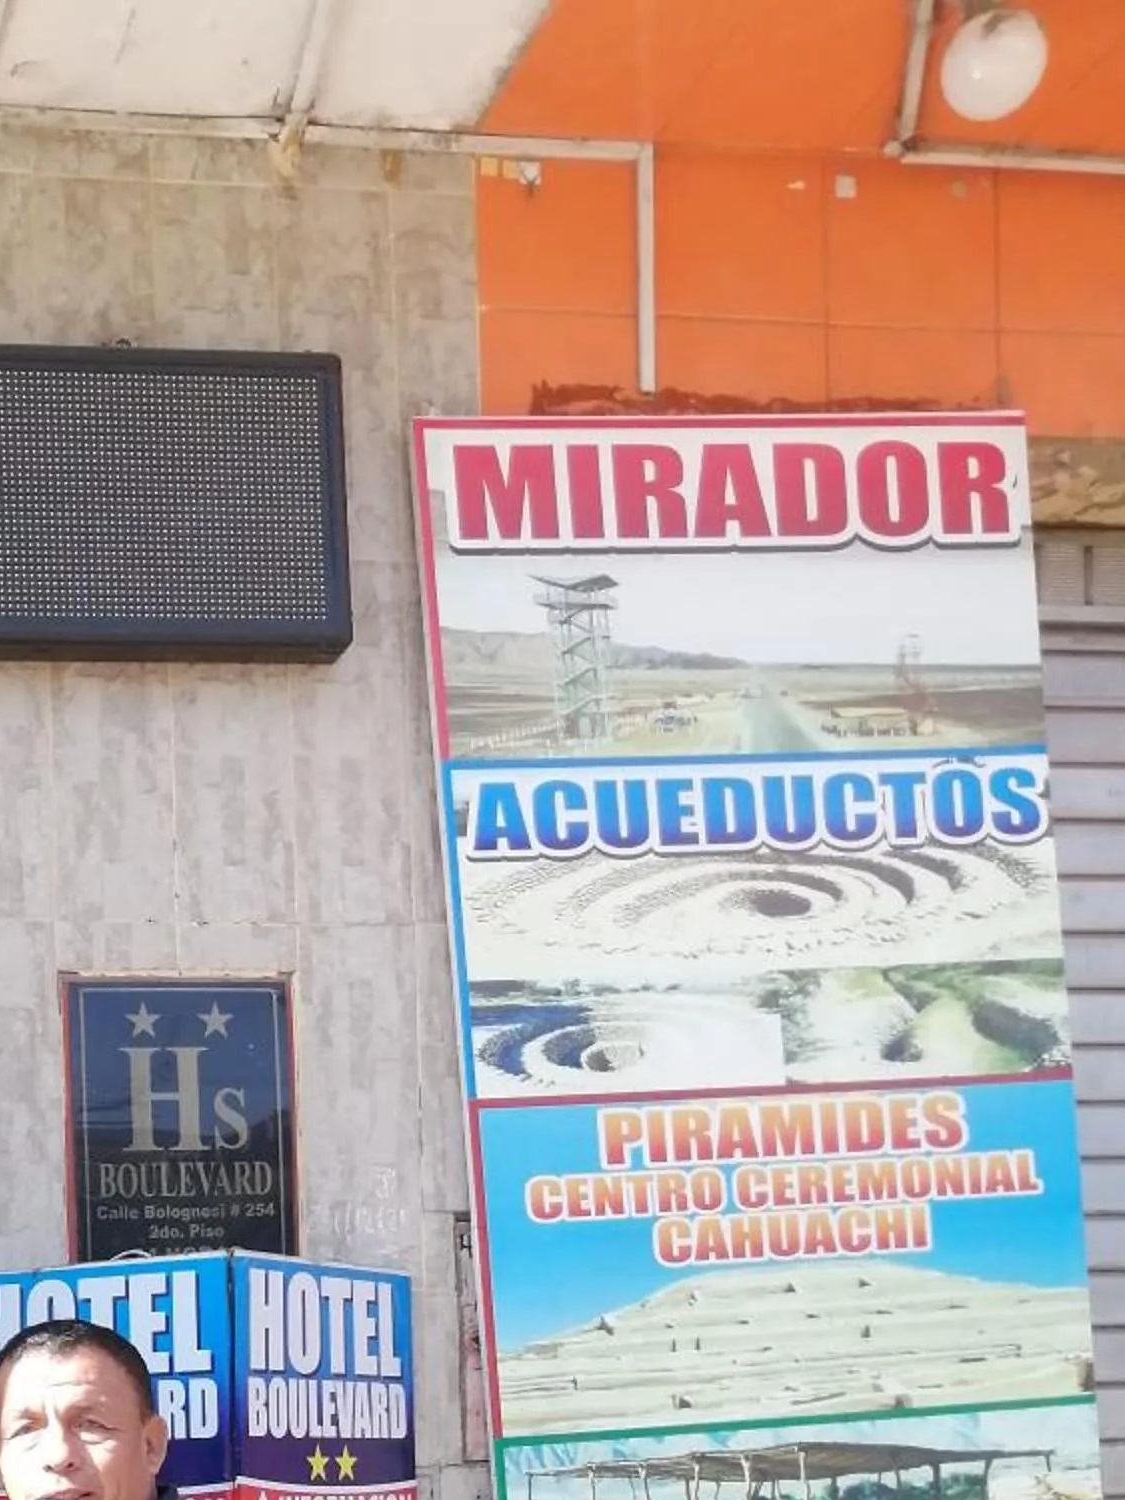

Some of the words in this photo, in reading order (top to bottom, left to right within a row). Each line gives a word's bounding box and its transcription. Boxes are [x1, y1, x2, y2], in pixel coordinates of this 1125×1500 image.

[452, 440, 1012, 540] MIRADOR
[473, 766, 1043, 851] ACUEDUCTOS
[602, 1095, 963, 1165] PIRAMIDES
[96, 1205, 140, 1220] Calle
[144, 1203, 226, 1221] Bolognesi
[245, 1202, 276, 1217] 254
[99, 1161, 273, 1199] BOULEVARD
[529, 1170, 724, 1221] CENTRO
[735, 1153, 1039, 1210] CEREMONIAL
[190, 1224, 225, 1239] Piso
[657, 1206, 930, 1264] CAHUACHI
[248, 1268, 402, 1377] HOTEL
[247, 1380, 407, 1440] BOULEVARD
